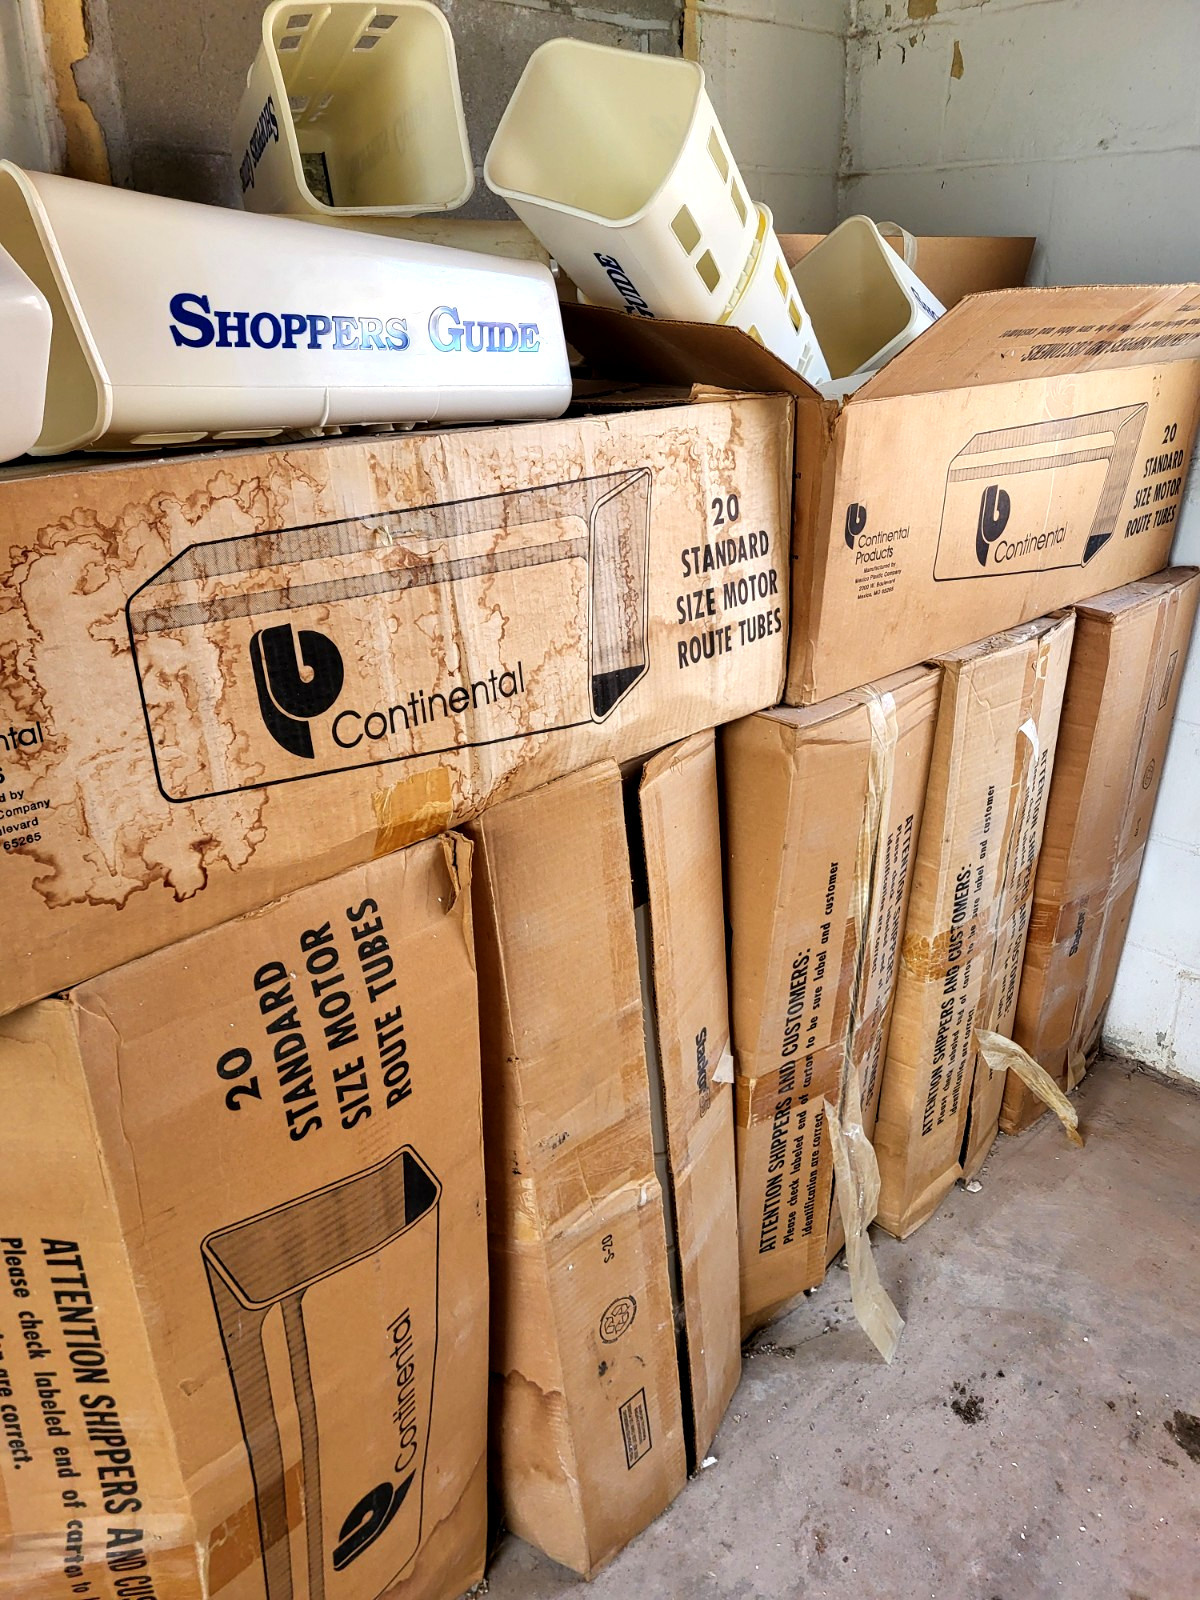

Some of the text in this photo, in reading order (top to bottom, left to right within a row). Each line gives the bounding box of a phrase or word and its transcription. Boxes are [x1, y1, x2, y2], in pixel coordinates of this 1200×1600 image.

[168, 292, 541, 354] SHOPPERS GUIDE
[1162, 422, 1177, 445] 20
[1143, 449, 1184, 478] STANDARD
[711, 494, 740, 526] 20
[1133, 477, 1182, 509] SIZE MOTOR
[858, 526, 910, 548] Continental
[994, 521, 1068, 563] Continental
[1124, 504, 1177, 539] ROUTE TUBES
[681, 530, 769, 578] STANDARD
[855, 545, 894, 565] Products
[676, 568, 778, 625] SIZE MOTOR
[677, 607, 782, 669] ROUTE TUBES
[331, 661, 525, 748] Continental
[9, 790, 24, 800] by
[983, 785, 995, 834] customer
[3, 831, 42, 850] 65265
[895, 814, 914, 906] ATTENTION
[980, 839, 988, 859] and
[974, 865, 985, 893] label
[346, 898, 412, 1109] ROUTE TUBES
[922, 863, 972, 1137] ATTENTION SHIPPERS AND CUSTOMERS:
[300, 921, 372, 1130] SIZE MOTOR
[948, 1029, 960, 1066] labeled
[254, 961, 323, 1141] STANDARD
[783, 862, 838, 1245] Please check labeled end of carton to be sure label and customer
[216, 1047, 262, 1111] 20
[759, 948, 811, 1254] ATTENTION SHIPPERS AND CUSTOMERS:
[937, 1095, 947, 1126] Please
[802, 1169, 818, 1237] identification
[813, 1108, 825, 1150] correct.
[0, 1238, 30, 1298] Please
[602, 1234, 615, 1263] S-20
[40, 1238, 110, 1383] ATTENTION
[18, 1311, 51, 1360] check
[34, 1371, 71, 1436] labeled
[387, 1307, 417, 1473] Continental
[1, 1404, 33, 1470] correct.
[79, 1394, 143, 1514] SHIPPERS
[53, 1446, 82, 1478] end
[62, 1489, 87, 1508] of
[105, 1528, 147, 1572] AND
[71, 1581, 92, 1593] to
